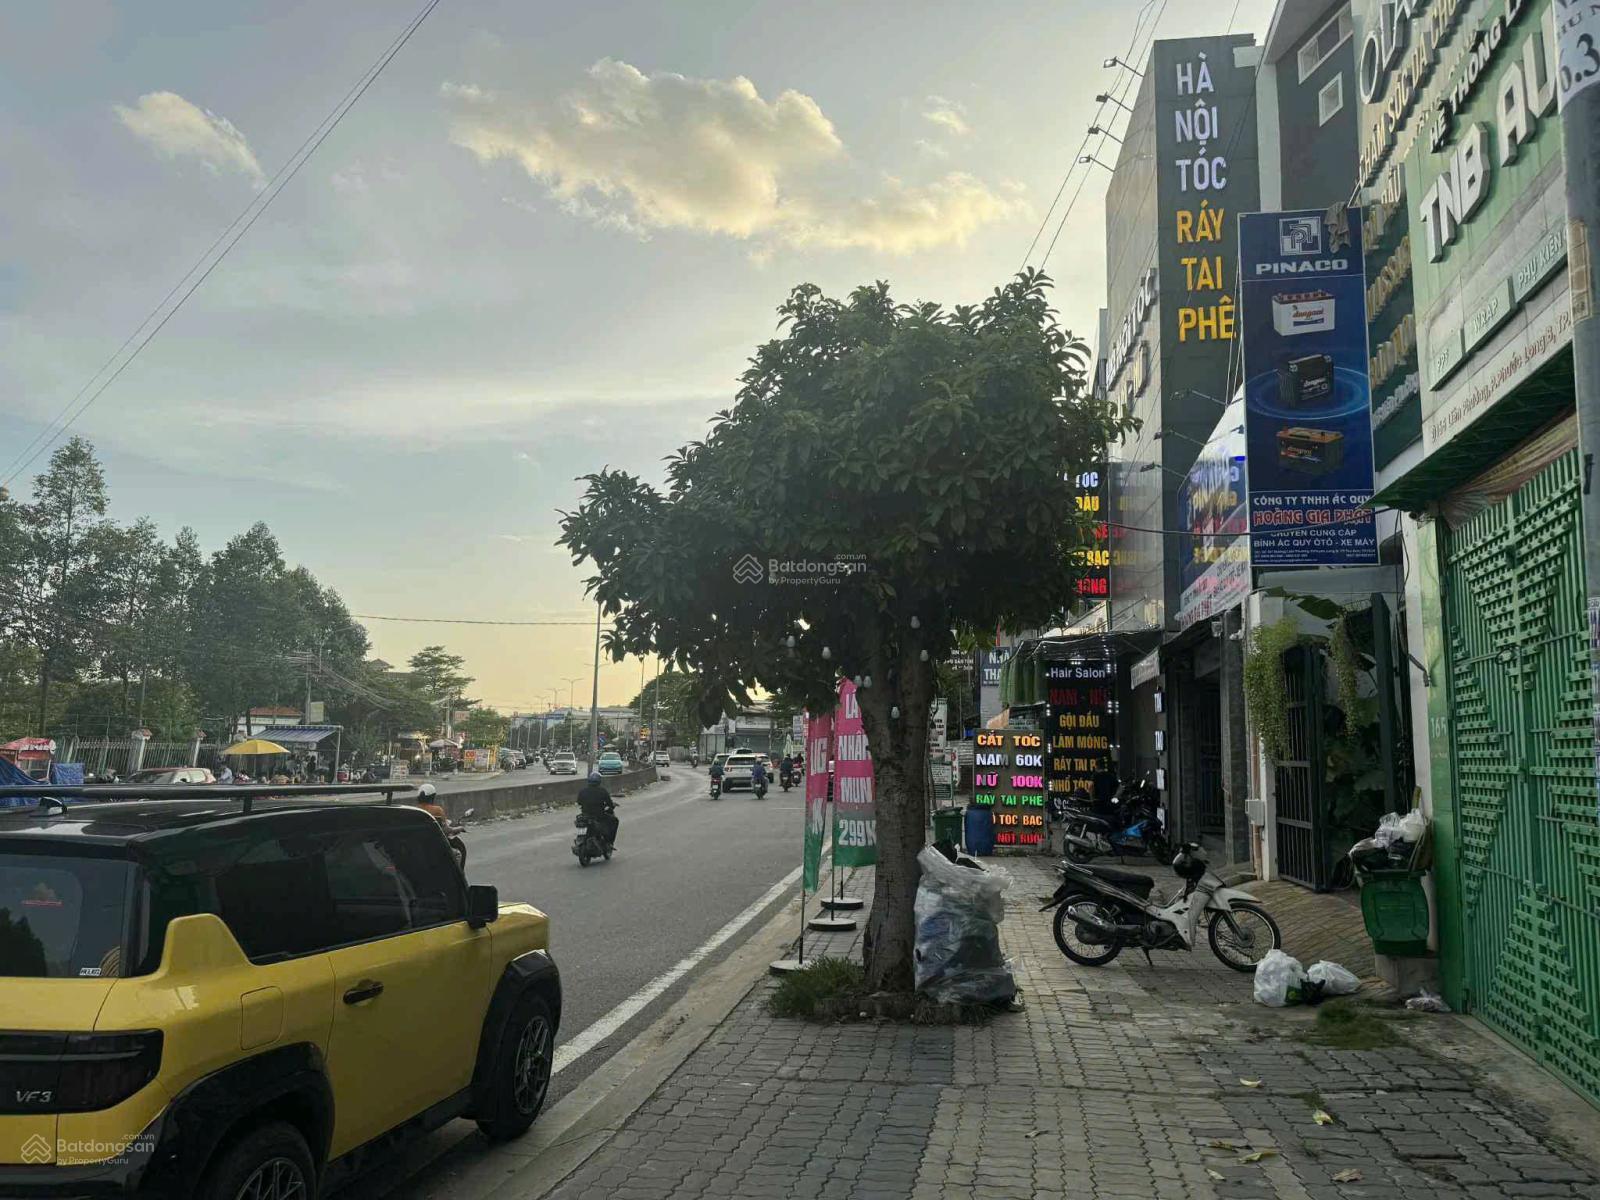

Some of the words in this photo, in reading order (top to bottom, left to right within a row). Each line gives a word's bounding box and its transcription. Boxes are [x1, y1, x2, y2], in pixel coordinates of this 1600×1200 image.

[1412, 32, 1429, 89] DA
[1176, 51, 1214, 95] HÀ
[1175, 98, 1219, 146] NỘI
[1175, 147, 1227, 192] TÓC
[1420, 122, 1488, 264] TNB
[1176, 199, 1225, 243] RÁY
[1181, 256, 1222, 291] TAI
[1256, 259, 1348, 275] PINACO
[1179, 294, 1234, 342] PHÊ
[1254, 495, 1282, 506] CÔNG
[1284, 496, 1298, 505] TY
[1300, 495, 1330, 505] TNHH
[1253, 507, 1303, 526] HOÀNG
[1306, 509, 1330, 524] GIA
[1309, 529, 1336, 537] CUNG
[1340, 538, 1353, 546] XE
[1051, 667, 1073, 678] Hair
[1075, 667, 1106, 678] Salon
[1059, 712, 1076, 730] GỘI
[977, 730, 1004, 746] CẮT
[1013, 733, 1041, 747] TÓC
[1053, 733, 1074, 748] LÀM
[976, 753, 1009, 766] NAM
[1015, 754, 1042, 767] 60K
[1054, 755, 1072, 771] RÁY
[1073, 758, 1088, 771] TAI
[976, 771, 998, 787] NỮ
[1010, 775, 1043, 788] 100K
[1000, 795, 1017, 805] TAI
[838, 819, 877, 847] 299K
